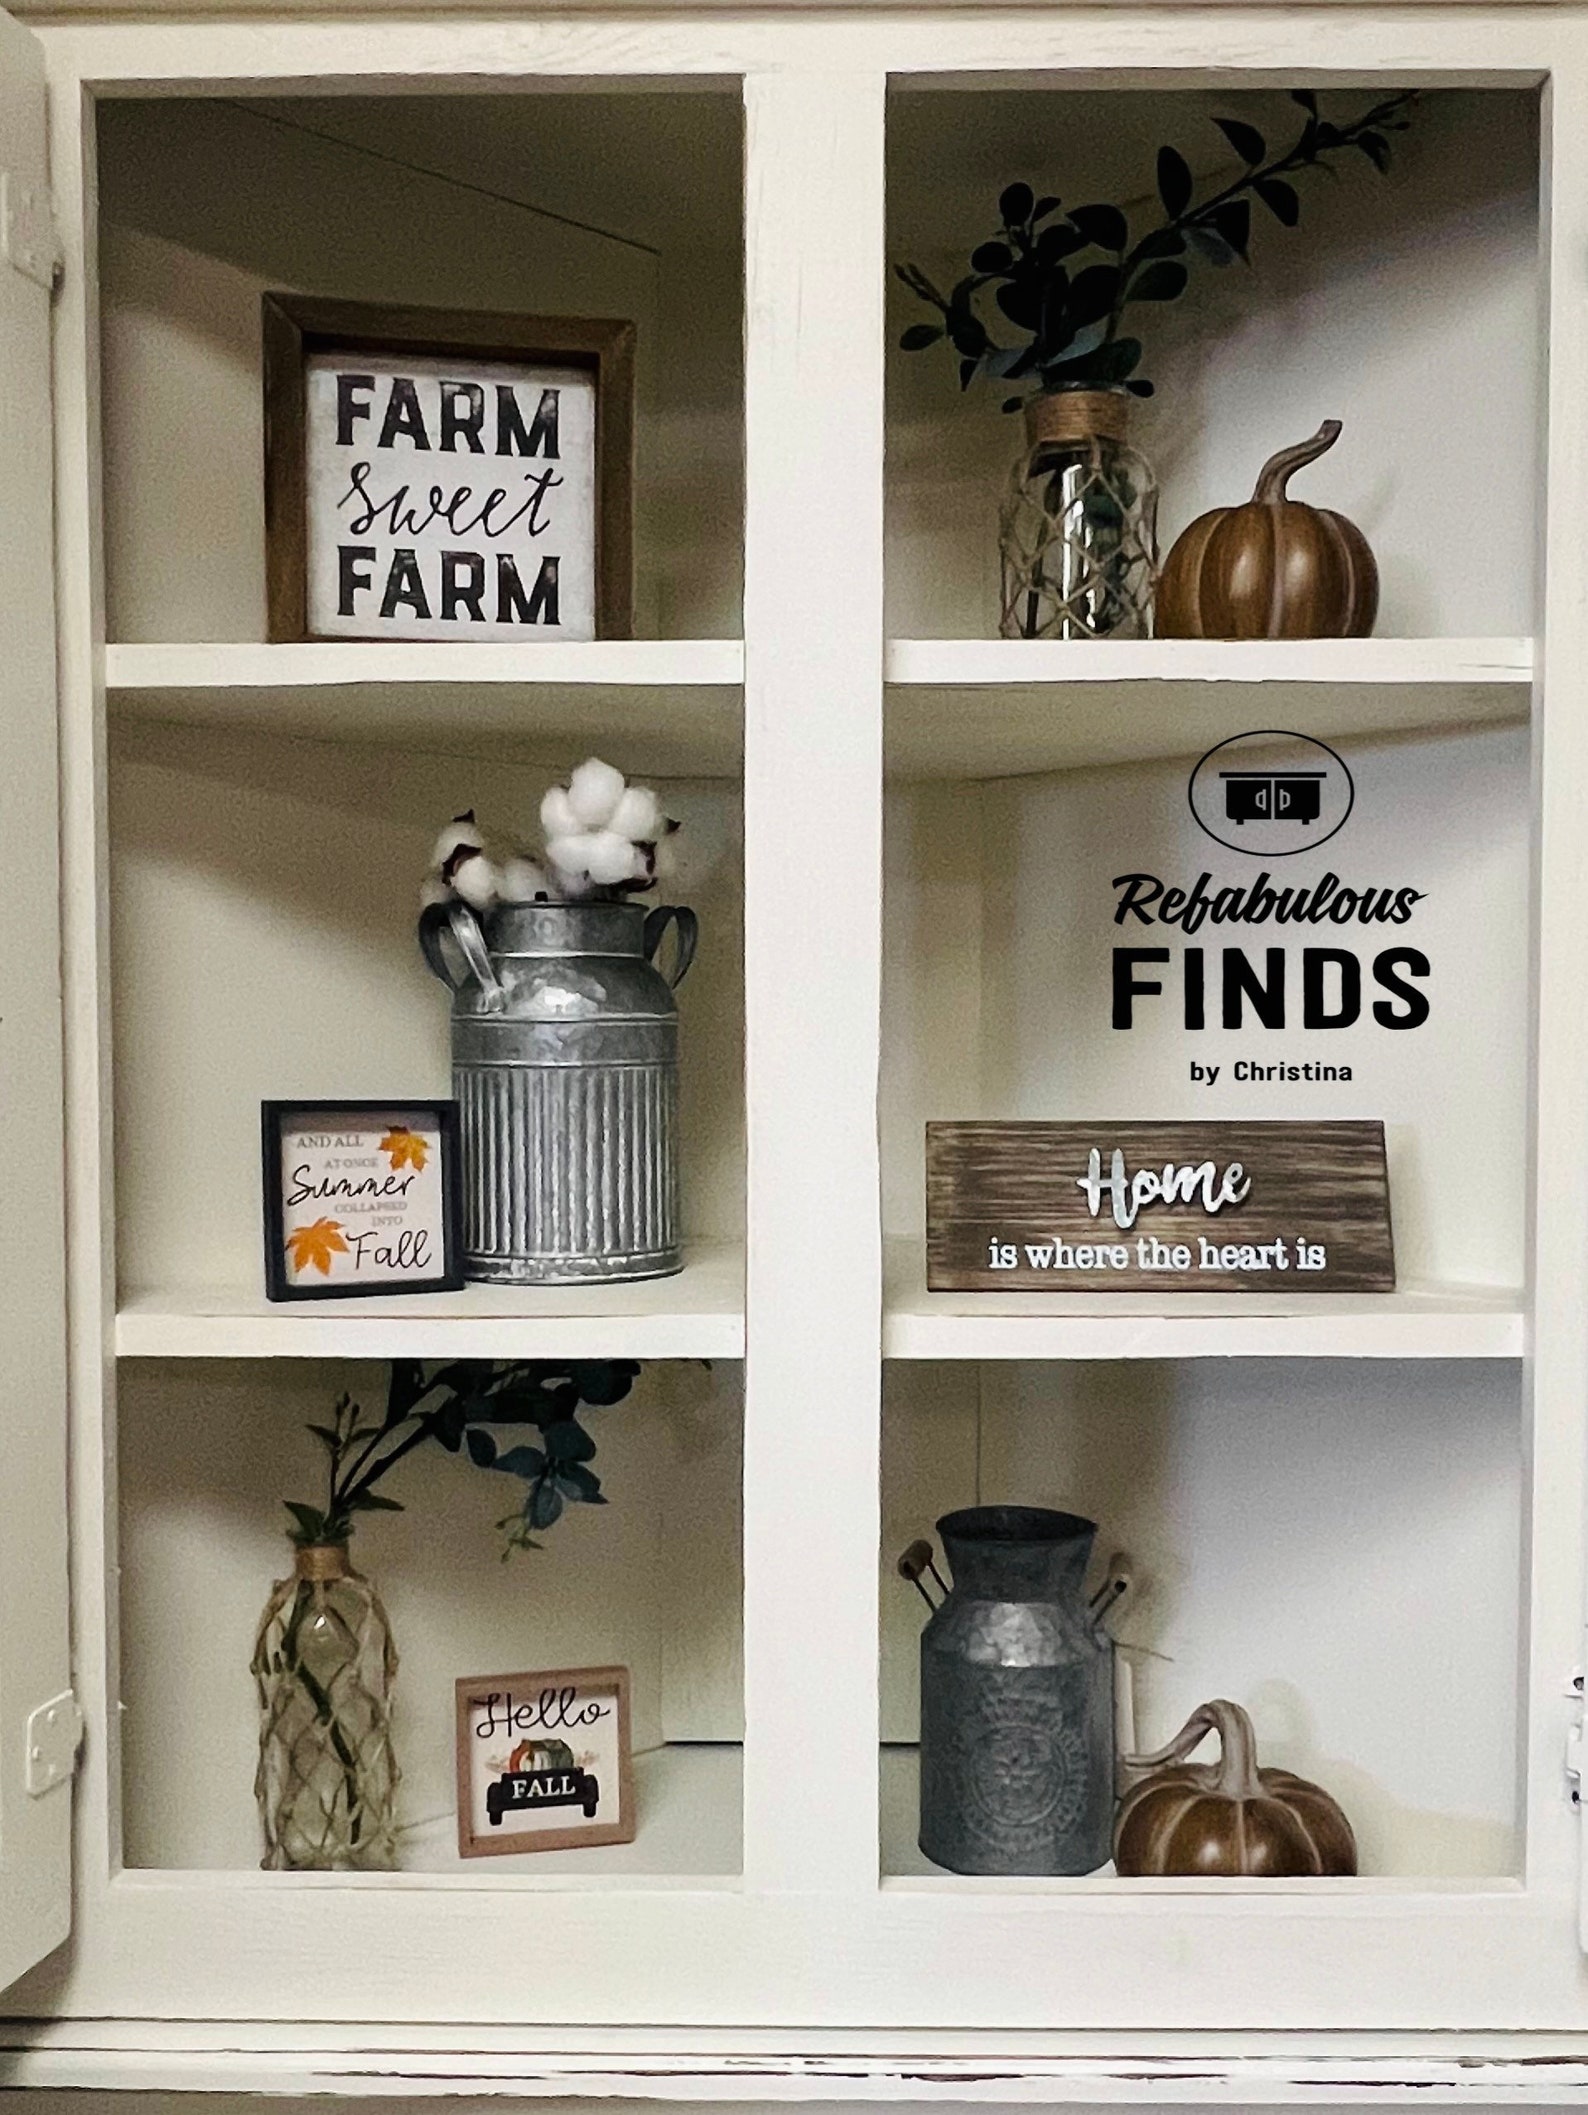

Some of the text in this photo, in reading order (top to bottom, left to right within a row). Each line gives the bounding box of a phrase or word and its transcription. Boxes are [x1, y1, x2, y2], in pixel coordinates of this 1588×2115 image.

[335, 374, 561, 459] FARM
[336, 545, 561, 626] FARM
[296, 1134, 364, 1149] AND ALL
[286, 1164, 415, 1207] Summer
[1077, 1147, 1251, 1230] Home
[345, 1229, 432, 1270] Fall
[988, 1237, 1327, 1270] is where the heart is
[473, 1686, 611, 1738] Hello
[512, 1776, 576, 1798] FALL
